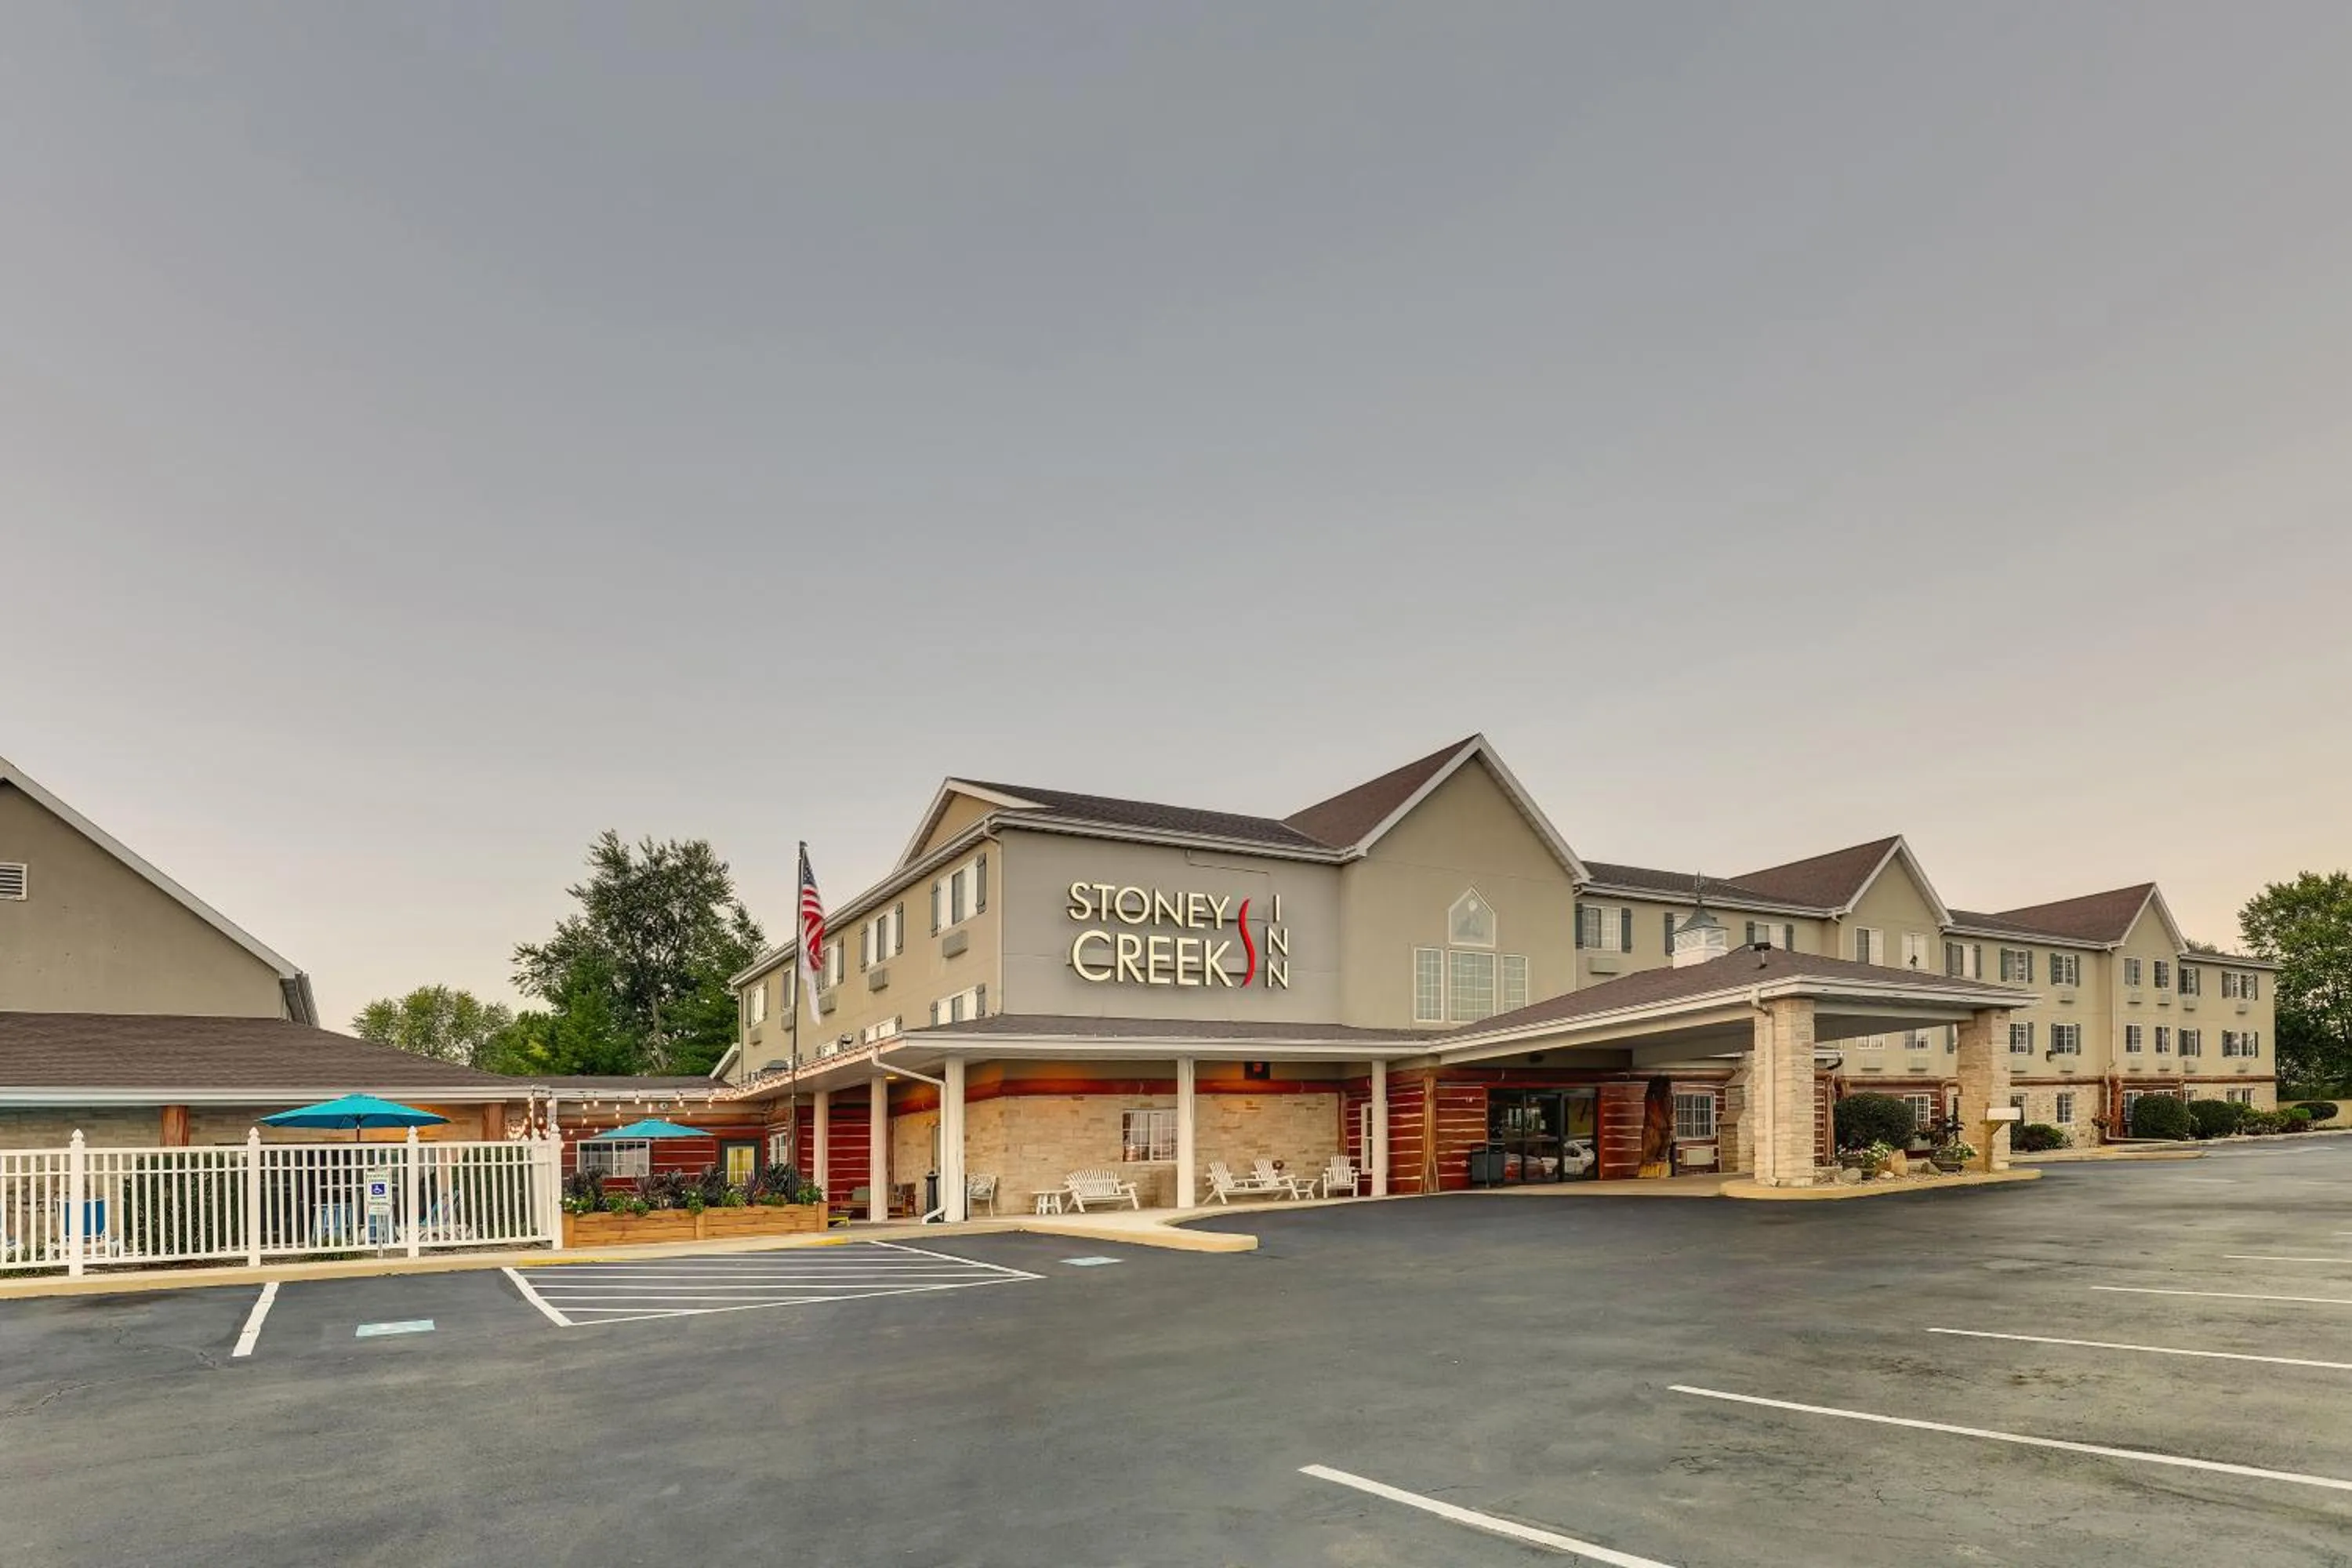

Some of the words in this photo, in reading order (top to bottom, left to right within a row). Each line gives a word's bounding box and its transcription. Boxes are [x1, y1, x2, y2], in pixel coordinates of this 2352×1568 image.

[1068, 882, 1230, 929] STONEY
[1072, 931, 1233, 987] CREEK
[1265, 894, 1288, 989] INN
